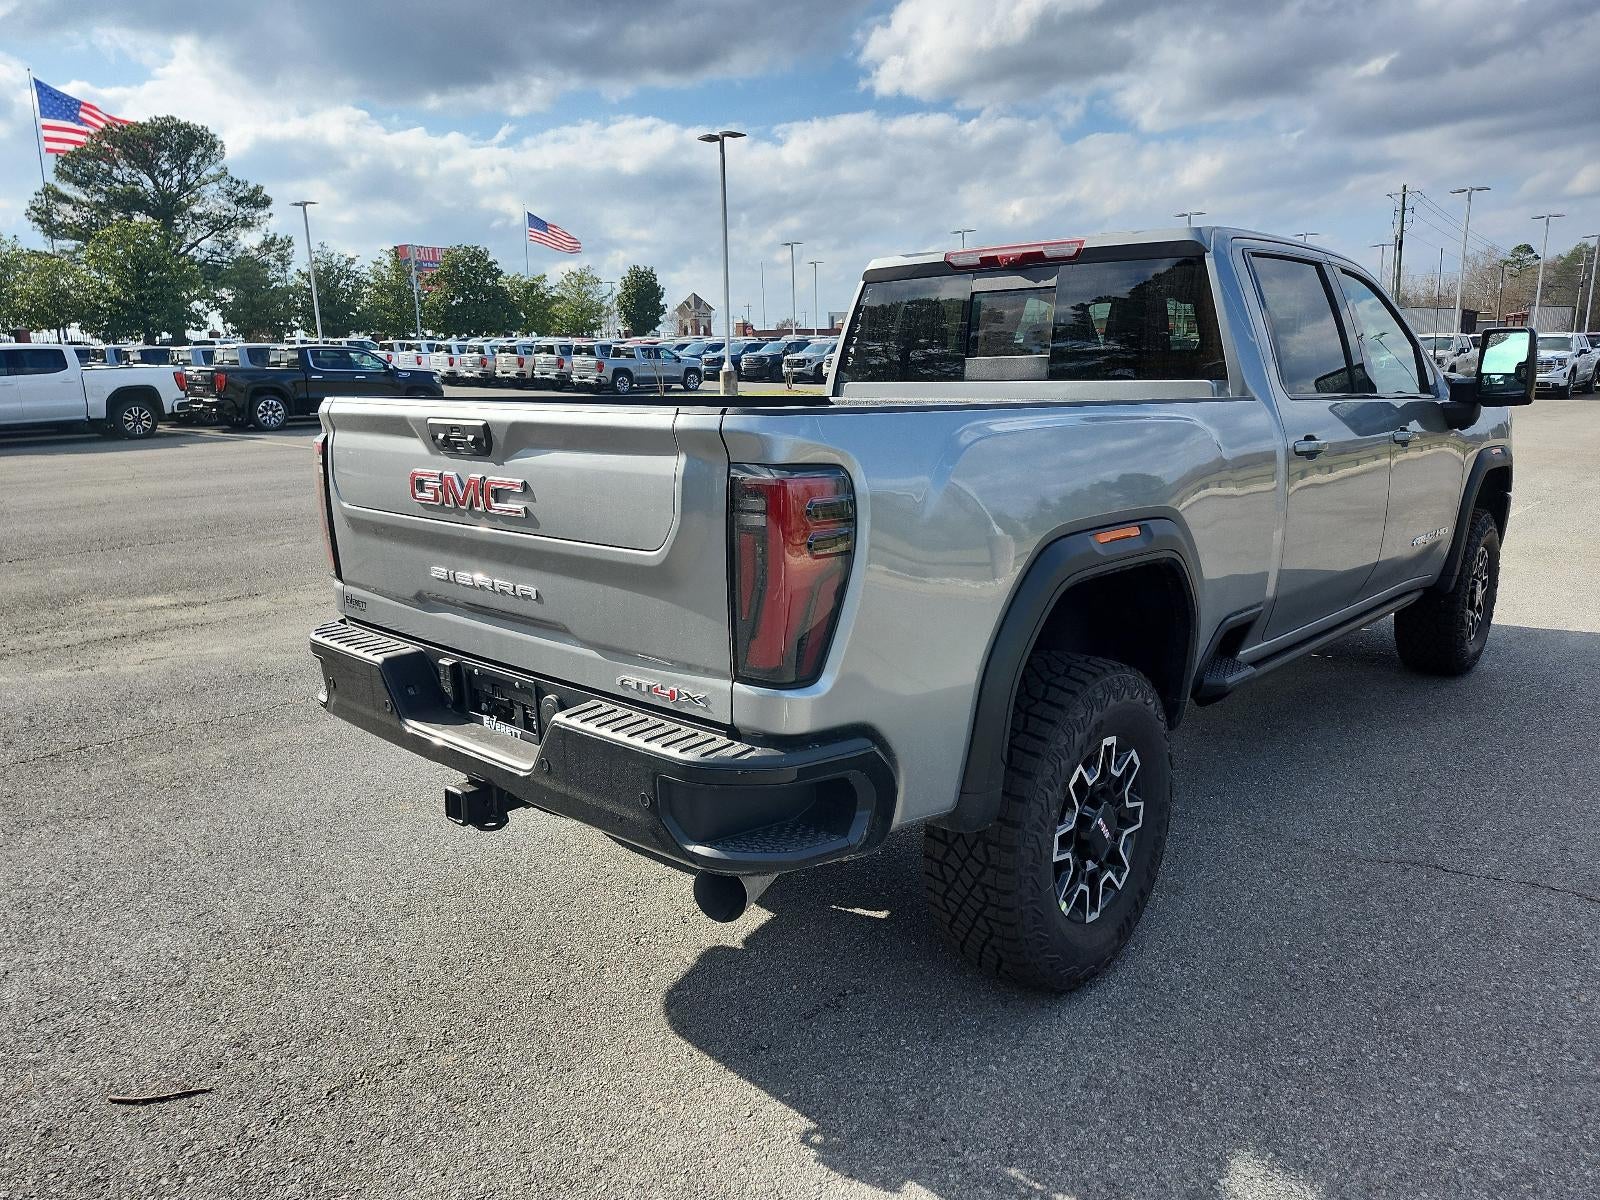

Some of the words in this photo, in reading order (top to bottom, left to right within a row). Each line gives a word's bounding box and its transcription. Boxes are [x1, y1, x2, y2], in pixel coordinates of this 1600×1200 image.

[416, 247, 433, 261] EXIT
[410, 467, 528, 519] GMC
[429, 566, 538, 600] SIERRA
[615, 674, 708, 708] AT4X
[482, 714, 522, 739] EVERETT
